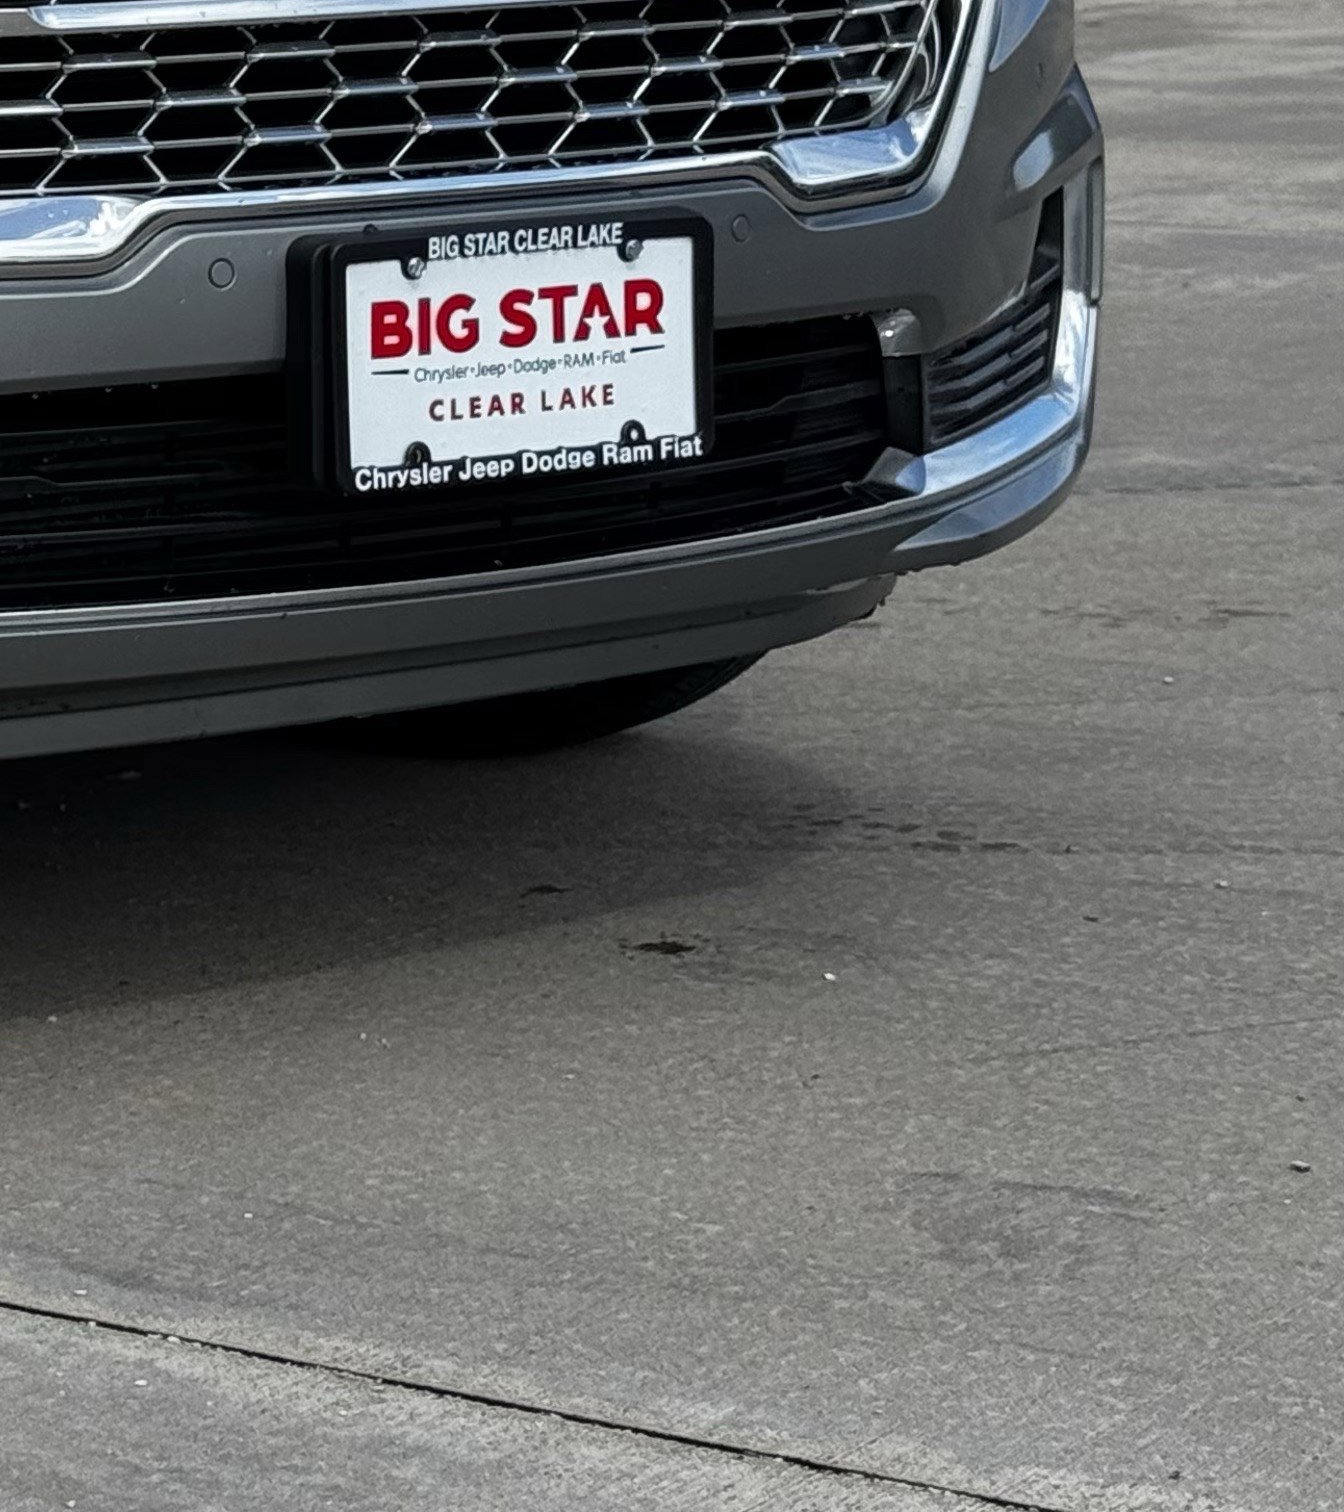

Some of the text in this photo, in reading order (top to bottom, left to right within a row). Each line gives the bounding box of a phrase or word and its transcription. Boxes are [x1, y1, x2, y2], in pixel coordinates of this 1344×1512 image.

[428, 222, 624, 259] BIG STAR CLEAR LAKE
[371, 278, 665, 359] BIG STAR
[414, 364, 469, 384] Chrysler
[475, 362, 506, 378] Jeep
[513, 357, 557, 374] Dodge
[563, 352, 595, 368] RAM
[429, 383, 614, 422] CLEAR LAKE
[354, 435, 703, 492] Chrysler Jeep Dodge Ram Fiat
